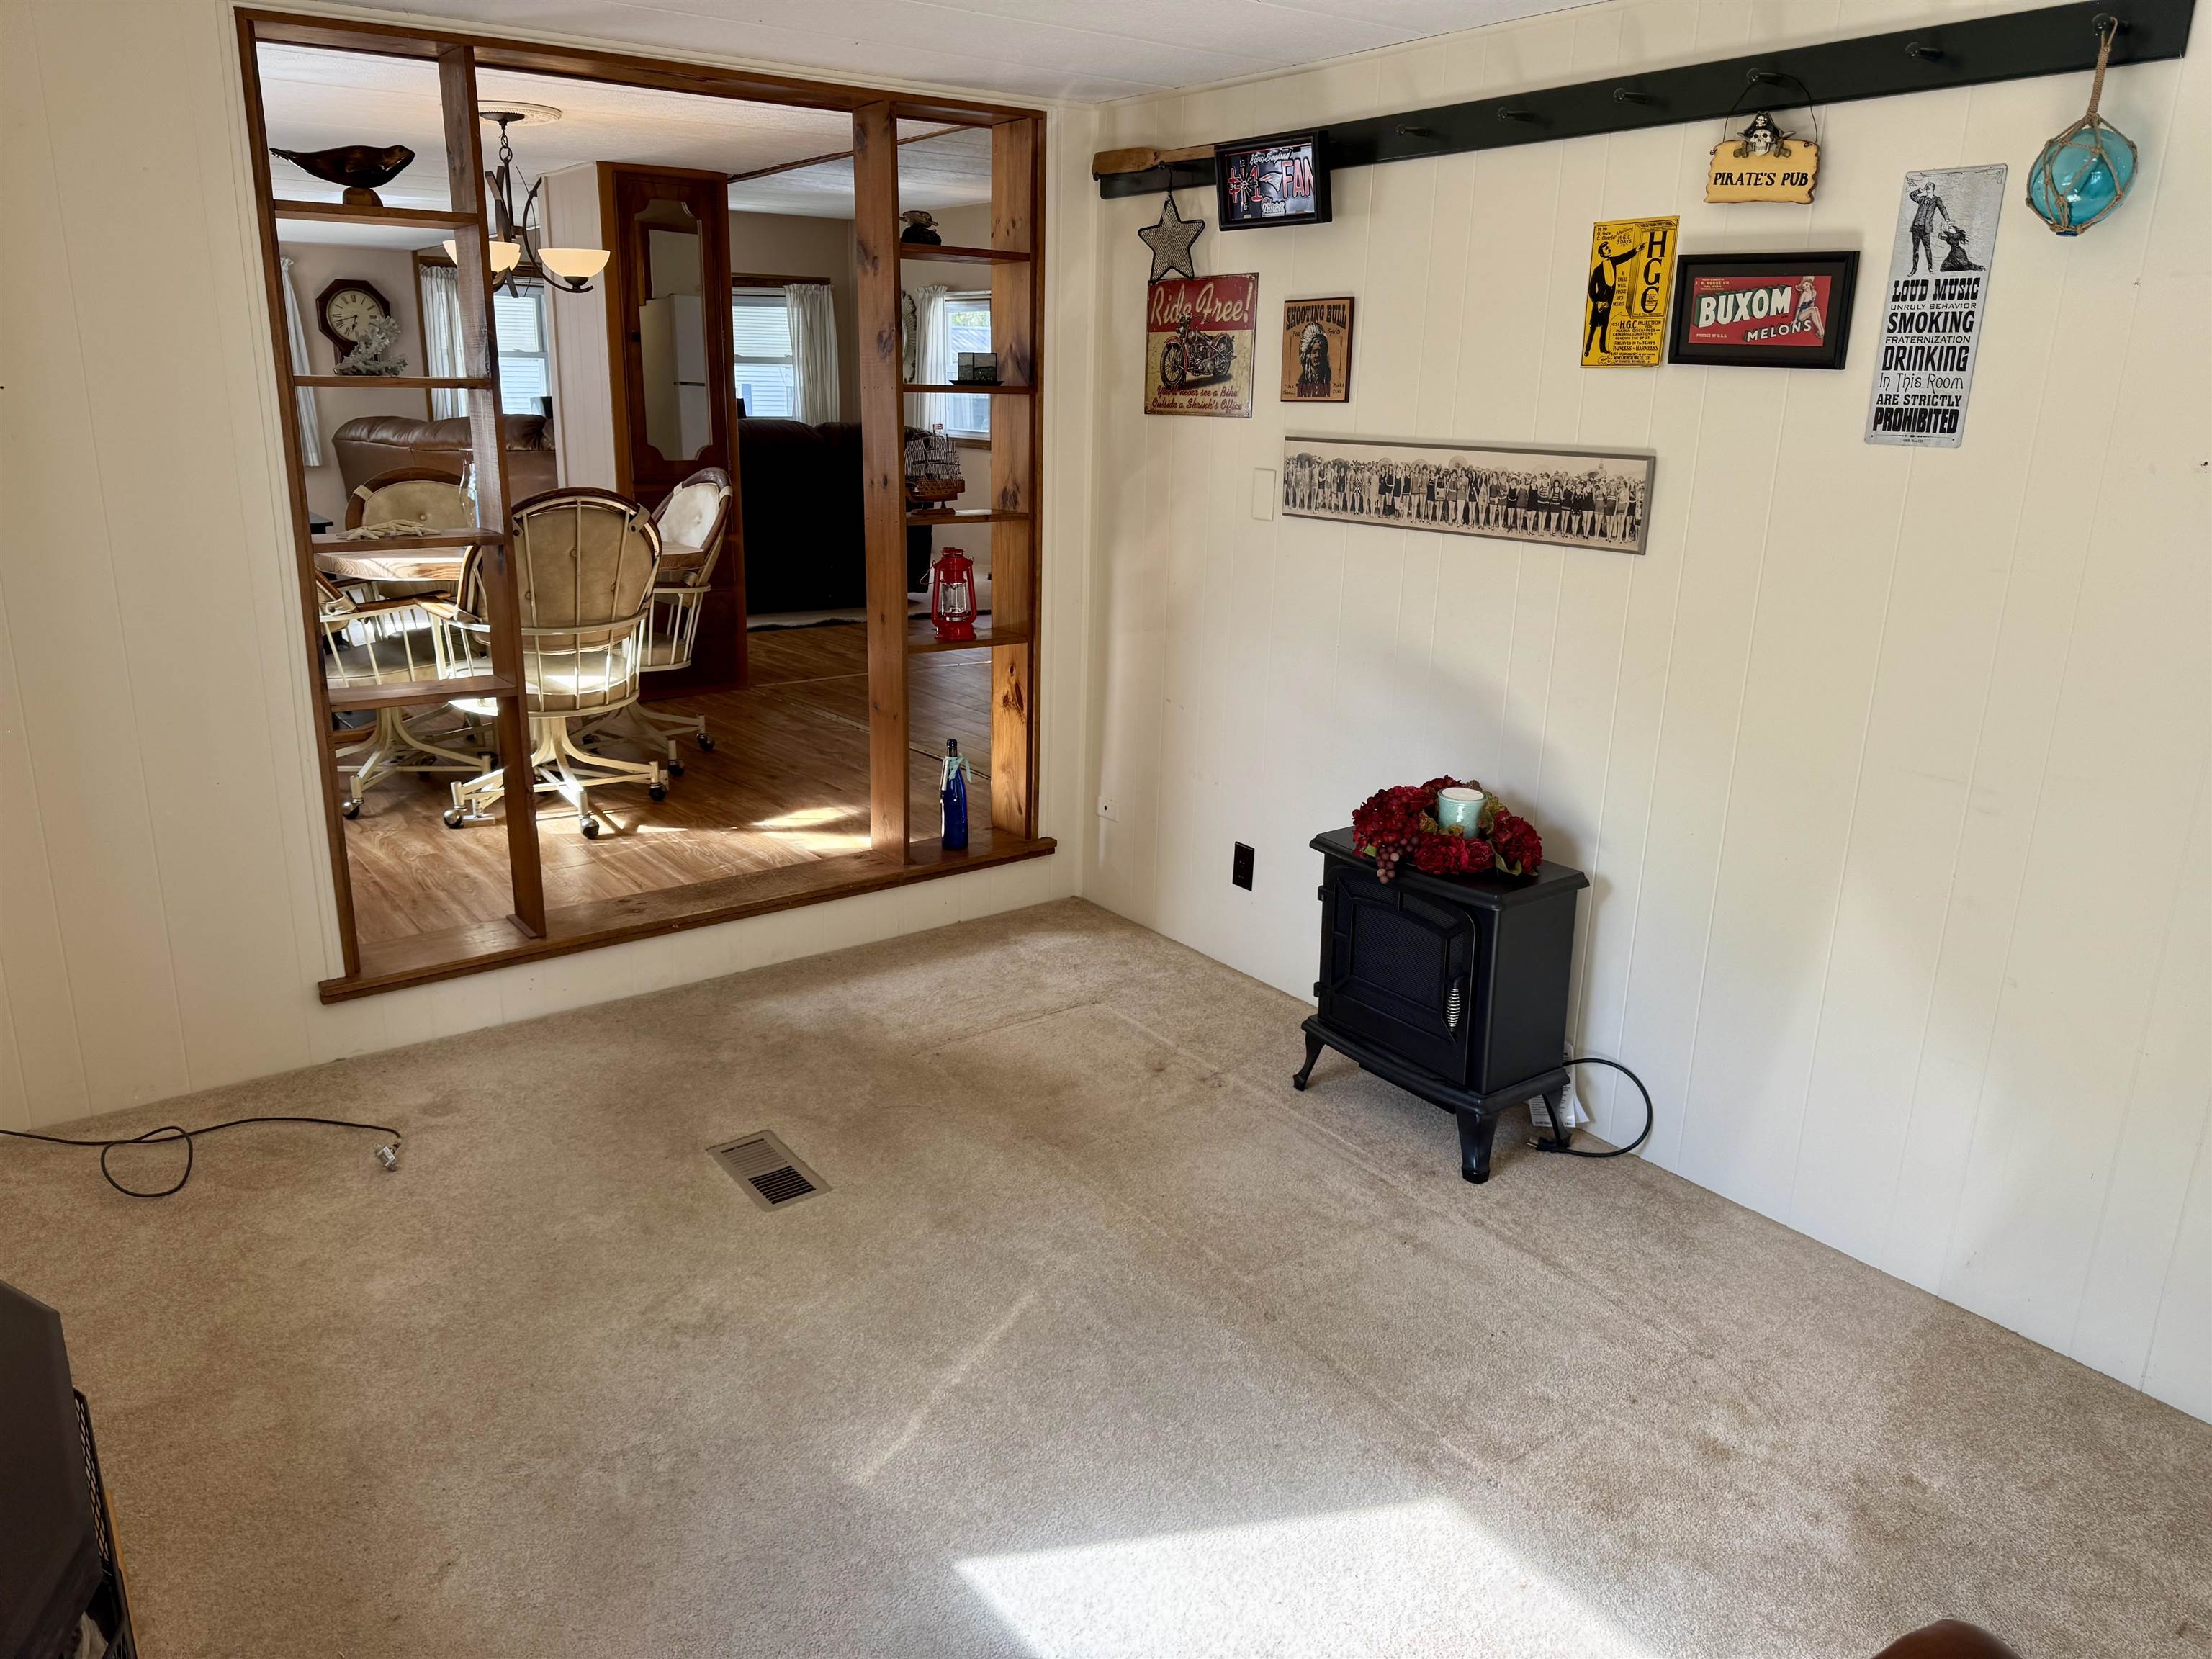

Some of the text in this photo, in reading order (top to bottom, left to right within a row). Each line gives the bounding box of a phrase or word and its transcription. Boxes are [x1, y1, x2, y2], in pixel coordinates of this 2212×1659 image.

[1713, 172, 1809, 186] PIRATE'S PUB
[1892, 277, 1980, 302] LOUD MUSIC
[1150, 282, 1253, 326] Ride Free!
[1698, 287, 1791, 328] BUXOM
[1286, 304, 1346, 331] SHOOTING BULL
[1887, 310, 1975, 333] SMOKING
[1746, 319, 1812, 342] MELONS
[1881, 346, 1970, 372] DRINKING
[1179, 388, 1200, 397] never
[1220, 385, 1238, 397] Bike
[1879, 372, 1964, 395] In This Room
[1152, 397, 1177, 408] Outside
[1220, 399, 1243, 414] Office
[1876, 393, 1963, 407] ARE STRICTLY
[1872, 407, 1960, 434] PROHIBITED
